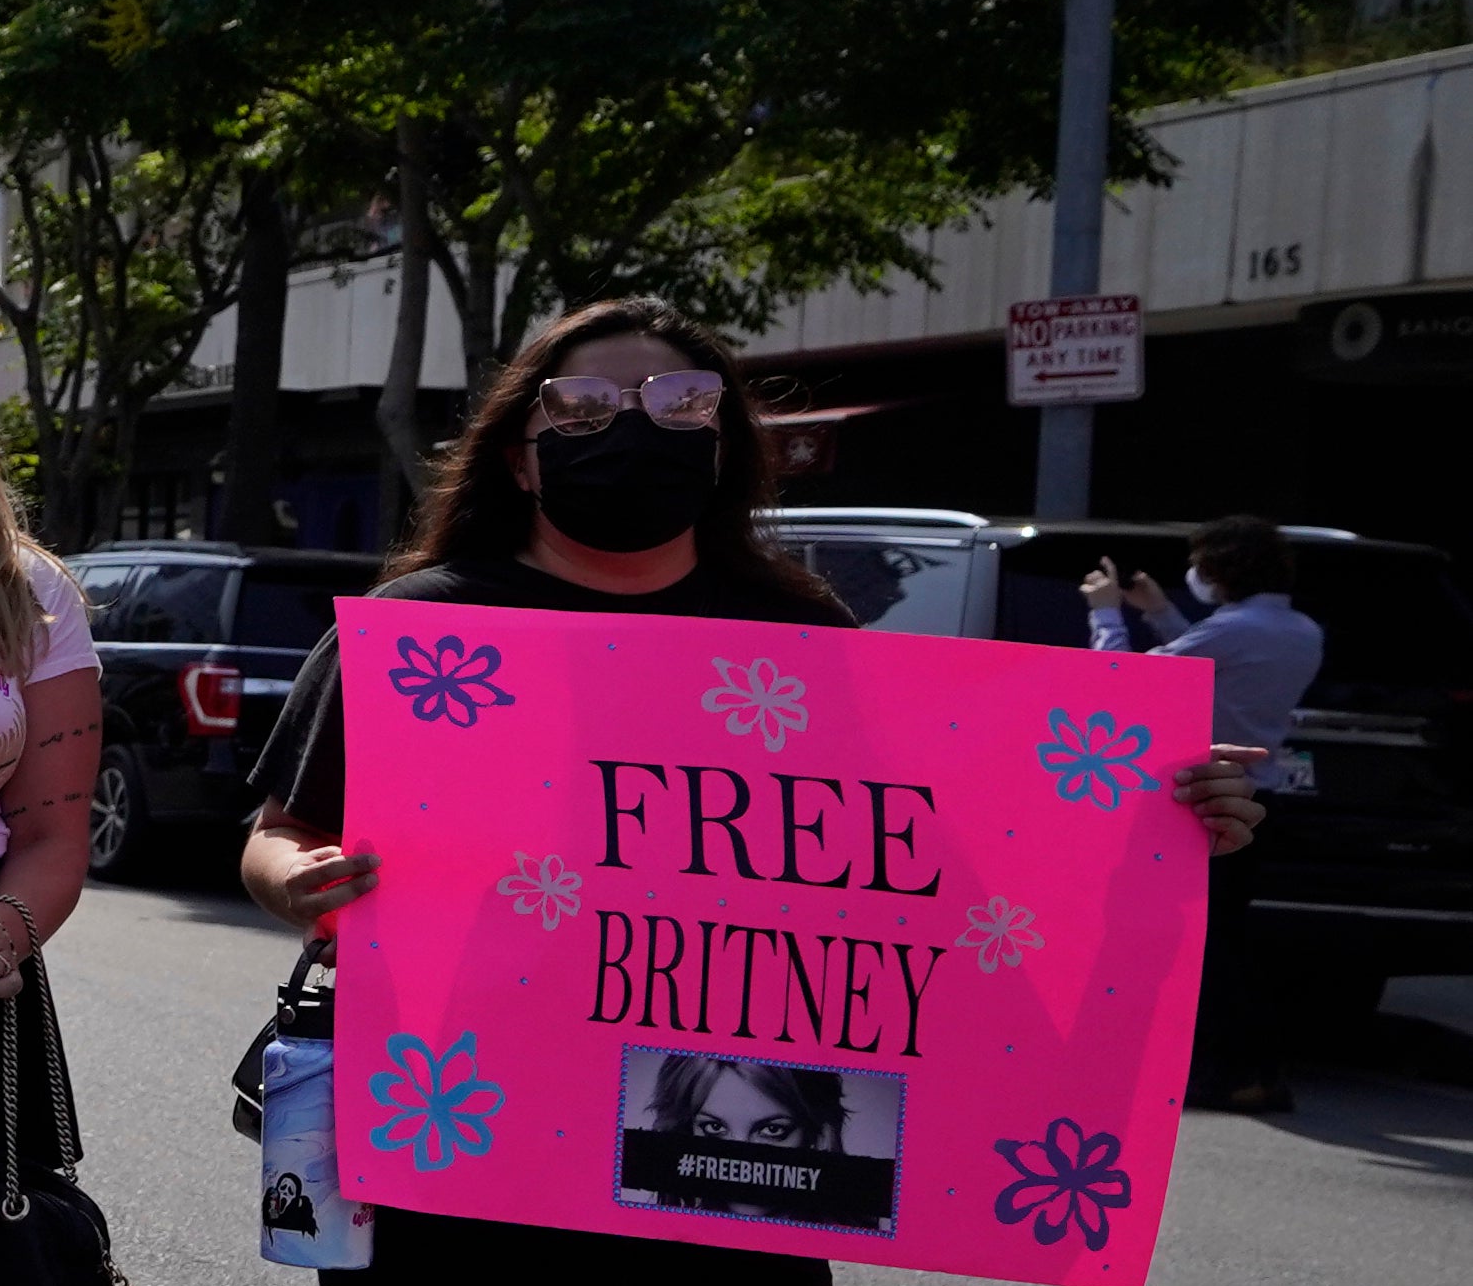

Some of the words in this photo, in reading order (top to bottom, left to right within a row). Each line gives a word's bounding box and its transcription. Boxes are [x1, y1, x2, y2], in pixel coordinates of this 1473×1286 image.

[1248, 242, 1301, 282] 165
[1013, 297, 1134, 320] TOW-AWAY
[1013, 320, 1049, 346] NO
[1054, 316, 1137, 340] PARKING
[1026, 348, 1068, 367] ANY
[1078, 345, 1126, 365] TIME
[588, 759, 942, 898] FREE
[586, 909, 948, 1058] BRITNEY
[677, 1153, 821, 1192] #FREEBRITNEY
